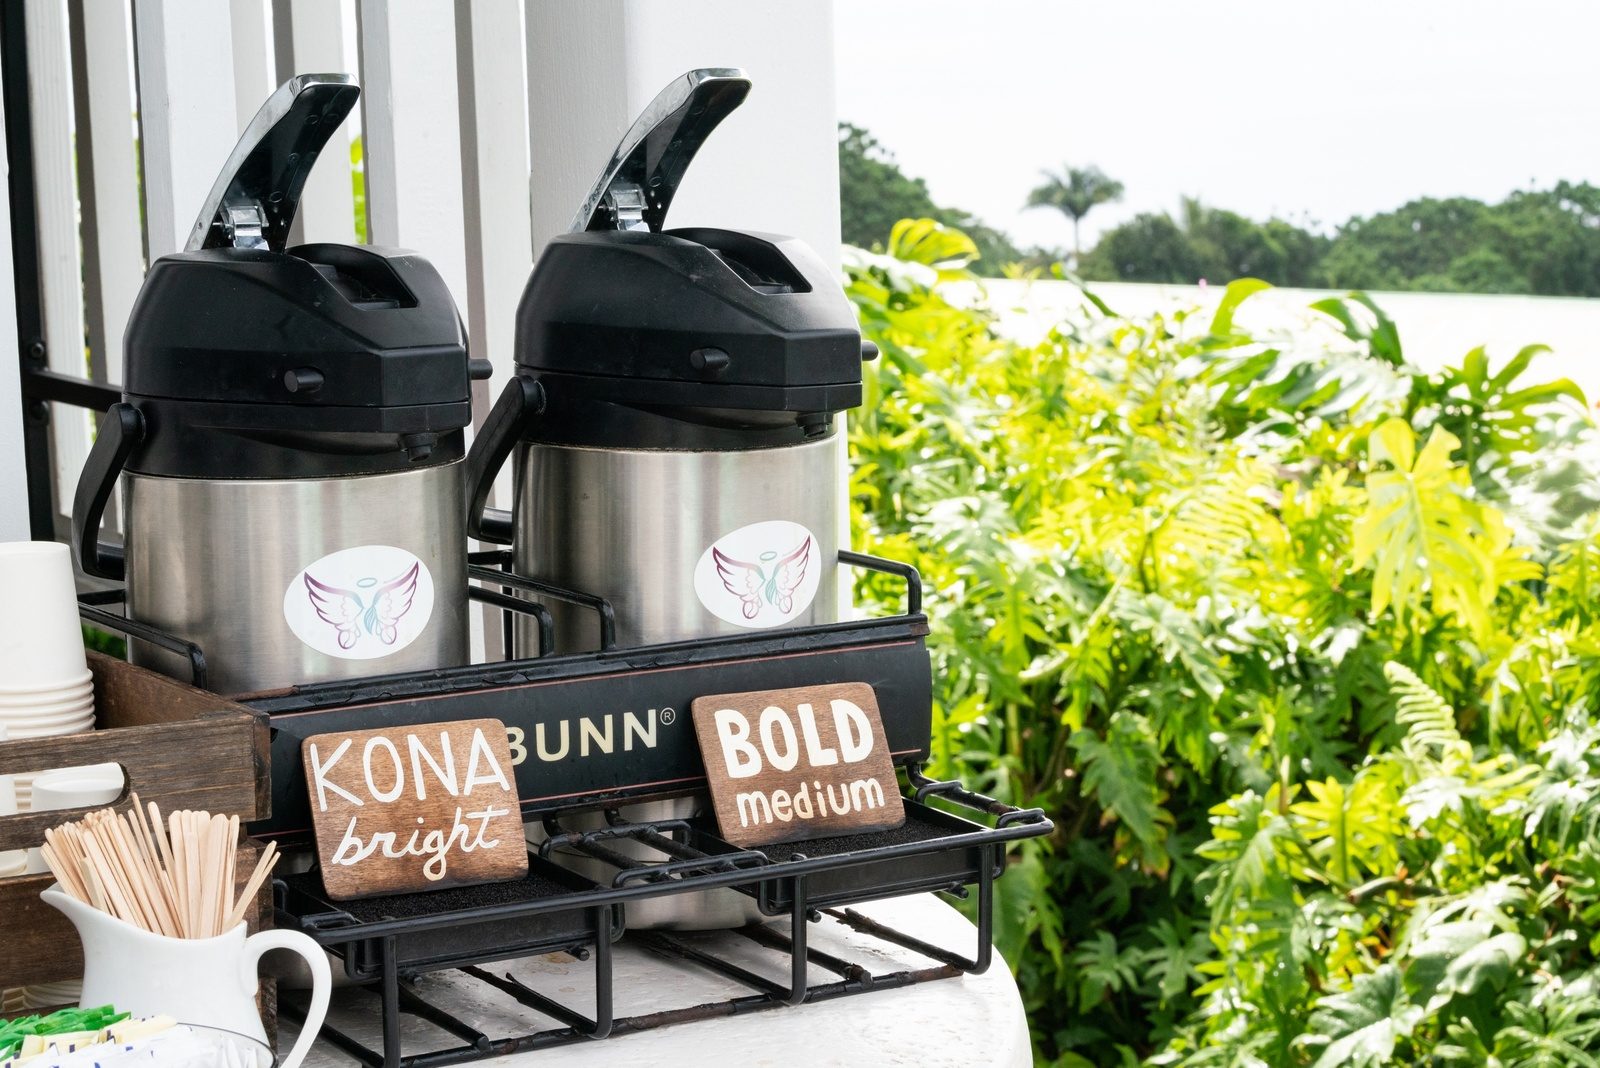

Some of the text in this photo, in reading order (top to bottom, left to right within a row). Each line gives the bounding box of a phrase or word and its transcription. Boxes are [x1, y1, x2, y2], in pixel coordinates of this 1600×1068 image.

[310, 728, 511, 812] KONA
[714, 699, 874, 778] BOLD
[736, 778, 885, 828] medium
[331, 805, 509, 881] bright
